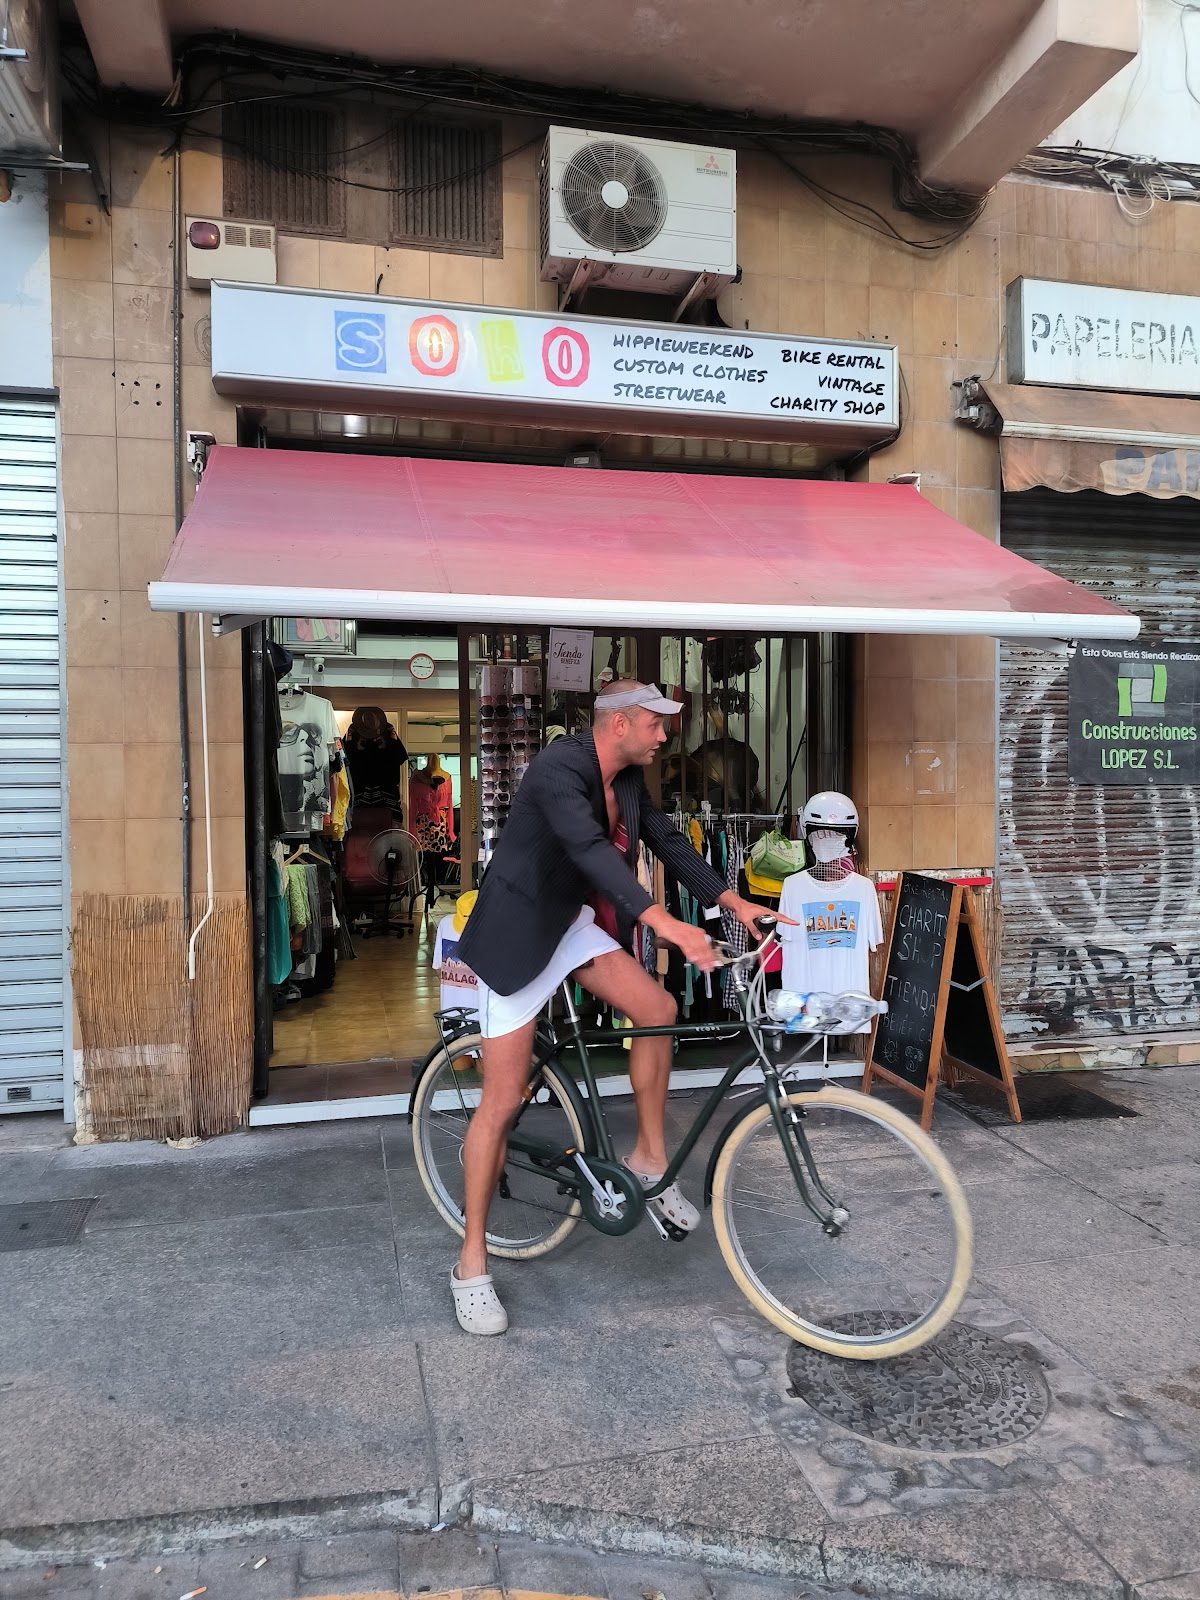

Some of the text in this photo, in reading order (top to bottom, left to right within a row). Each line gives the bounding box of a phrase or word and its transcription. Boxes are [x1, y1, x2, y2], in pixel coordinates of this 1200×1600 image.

[613, 334, 754, 359] HIPPIEWEEKEND
[1031, 312, 1200, 365] PAPELERIA
[781, 349, 885, 369] BIKE RENTAL
[613, 358, 768, 383] CUSTOM CLOTHES
[613, 382, 726, 405] STREETWEAR
[818, 375, 885, 396] VINTAGE
[770, 396, 885, 415] CHARITY SHOP
[1081, 648, 1100, 657] Esta
[1101, 649, 1122, 658] Obra
[1123, 650, 1140, 659] Está
[1141, 651, 1168, 660] Siendo
[1081, 719, 1197, 741] Construcciones
[1101, 748, 1180, 769] LOPEZ S.L.
[888, 975, 936, 1015] TIENDA
